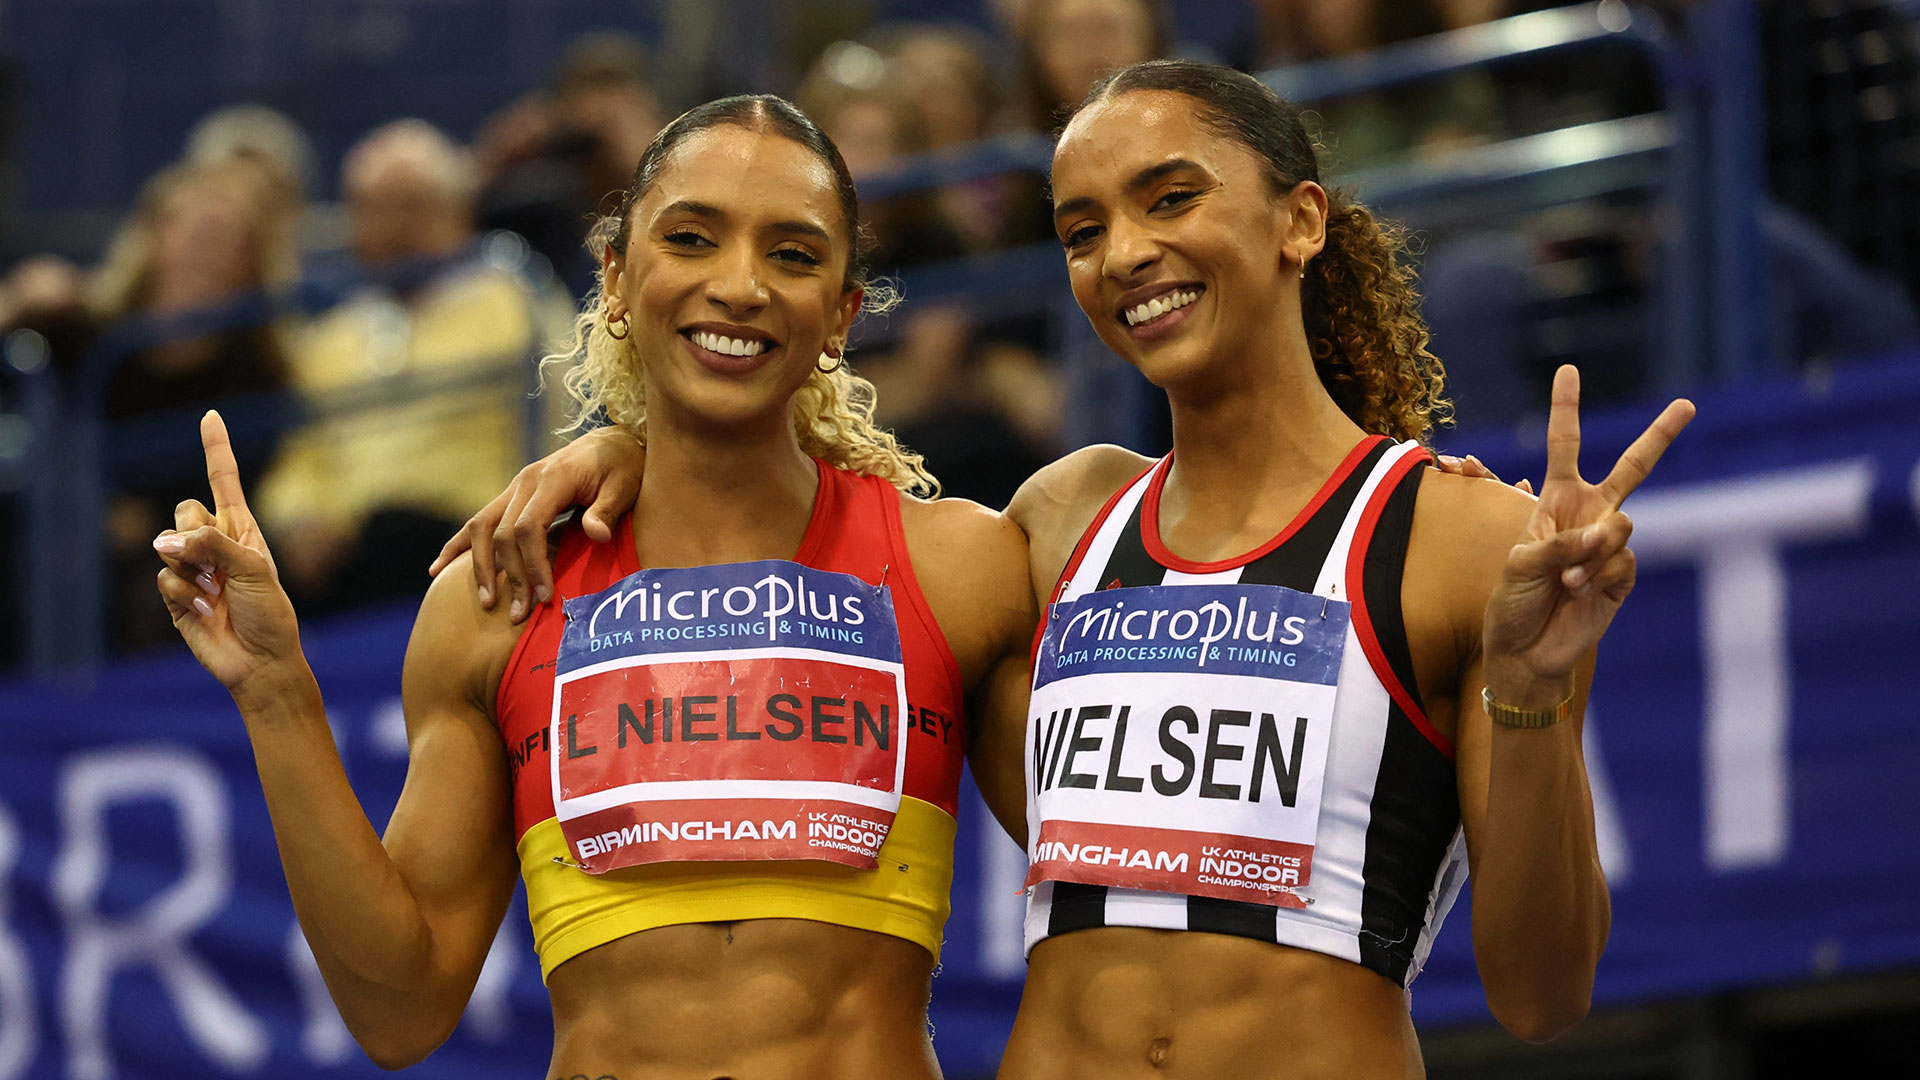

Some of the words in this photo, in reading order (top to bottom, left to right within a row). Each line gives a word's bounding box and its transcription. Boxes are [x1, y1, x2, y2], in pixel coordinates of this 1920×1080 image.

[590, 631, 634, 652] DATA
[641, 622, 765, 642] PROCESSING
[779, 620, 792, 634] &
[797, 621, 864, 644] TIMING
[1057, 652, 1088, 669] DATA
[1093, 646, 1198, 661] PROCESSING
[1208, 646, 1221, 660] &
[1227, 647, 1297, 667] TIMING
[567, 714, 598, 760] L
[617, 693, 890, 752] NIELSEN
[1032, 704, 1309, 808] NIELSEN
[808, 811, 828, 822] UK
[829, 813, 890, 835] ATHLETICS
[575, 819, 797, 860] BIRMINGHAM
[1199, 856, 1300, 885] INDOOR
[1201, 845, 1222, 857] UK
[1223, 848, 1301, 868] ATHLETICS
